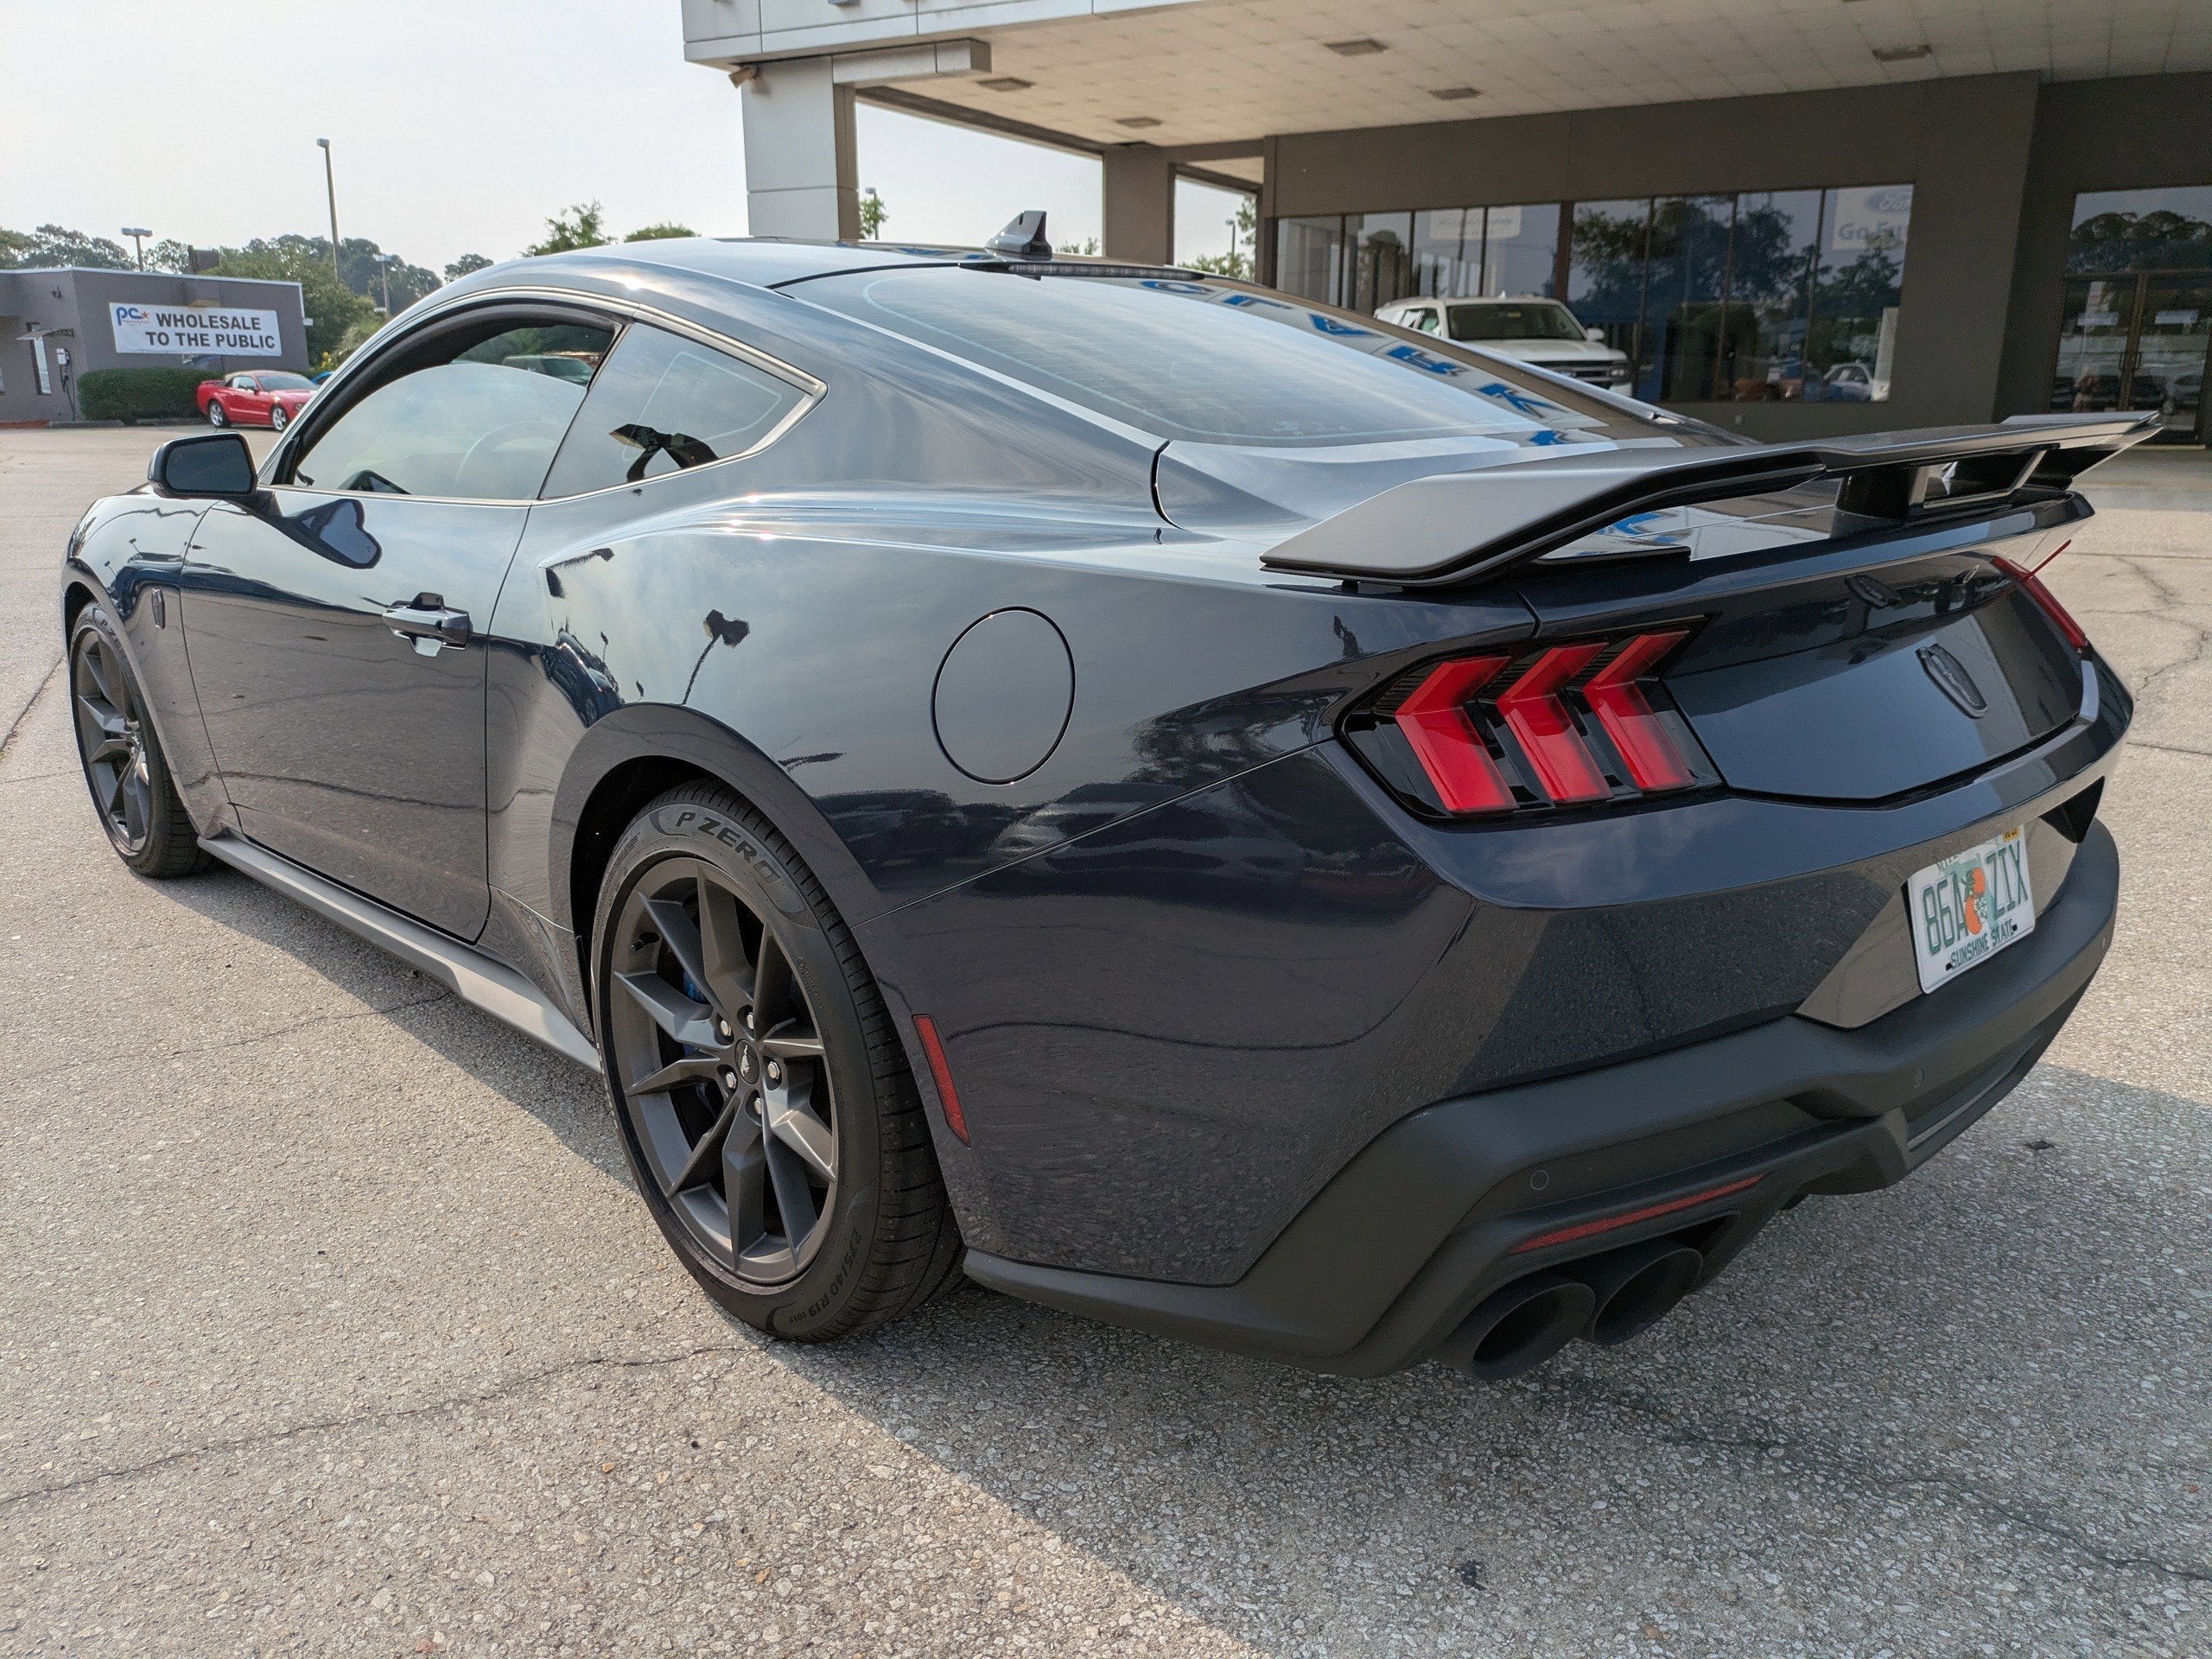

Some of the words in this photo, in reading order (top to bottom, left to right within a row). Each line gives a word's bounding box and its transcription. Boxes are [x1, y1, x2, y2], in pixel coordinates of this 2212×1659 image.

[156, 313, 262, 330] WHOLESALE
[145, 331, 169, 346] TO
[175, 332, 211, 346] THE
[217, 334, 276, 348] PUBLIC
[676, 811, 696, 827] P
[697, 817, 781, 884] ZERO
[1949, 932, 1990, 969] SUNSHINE
[1991, 918, 2014, 948] STATE
